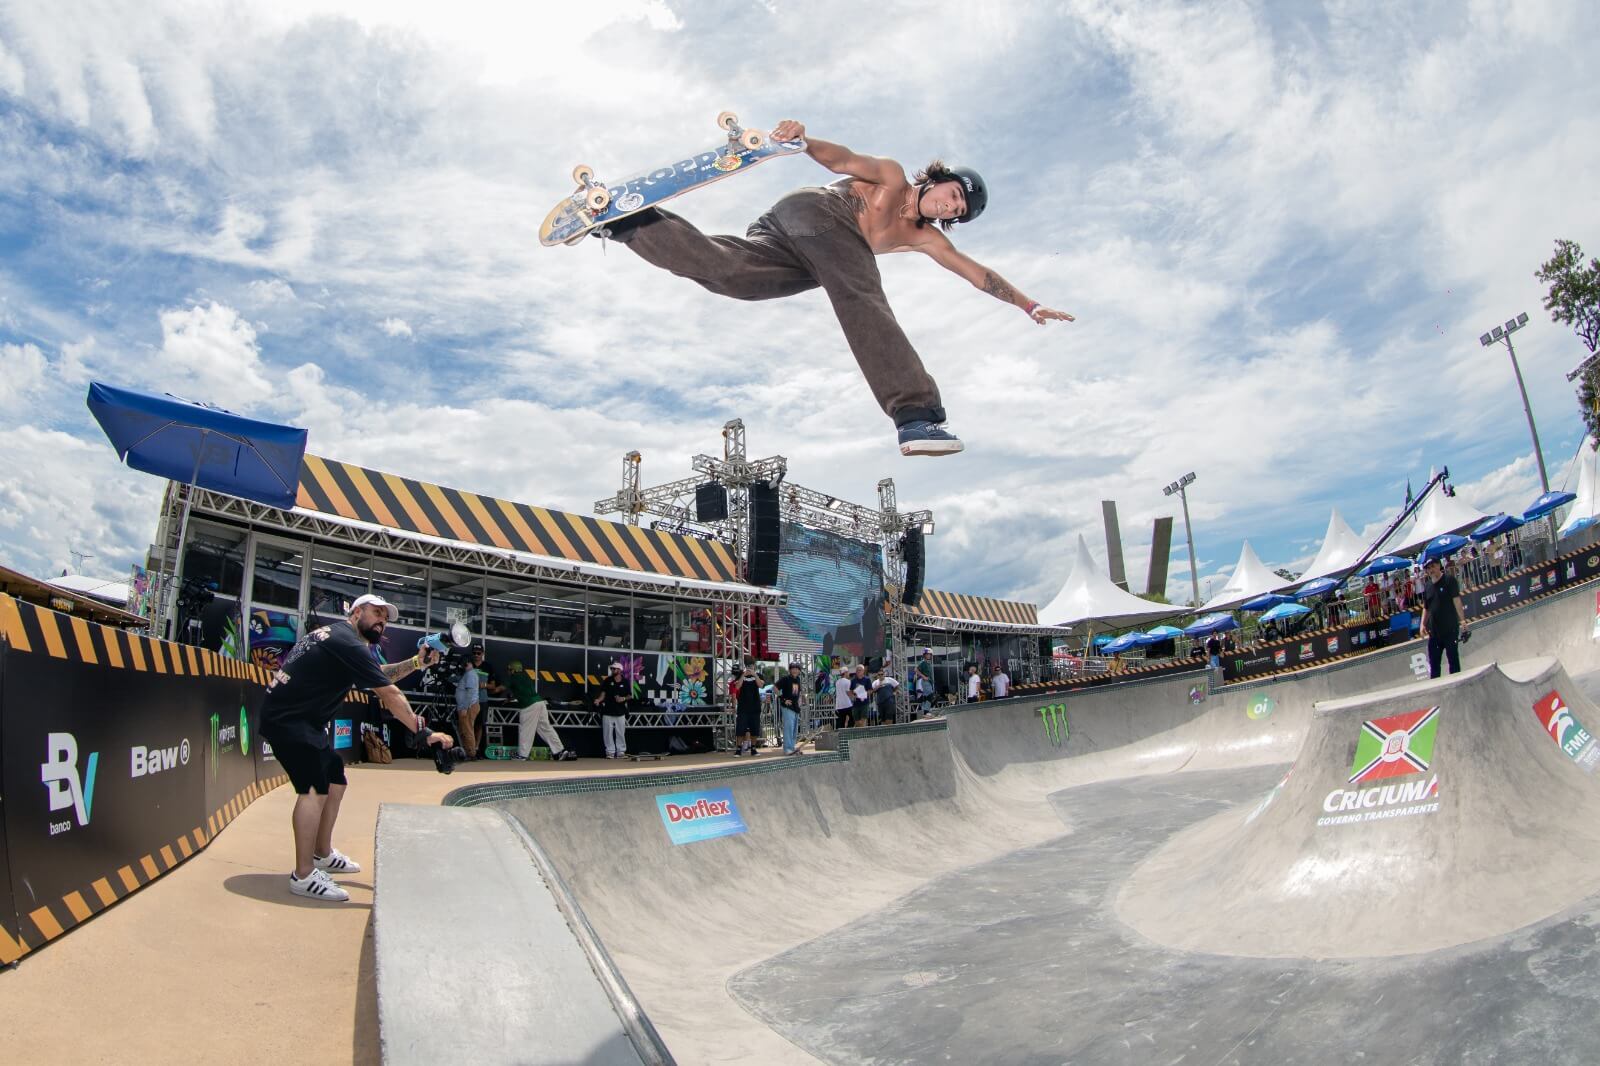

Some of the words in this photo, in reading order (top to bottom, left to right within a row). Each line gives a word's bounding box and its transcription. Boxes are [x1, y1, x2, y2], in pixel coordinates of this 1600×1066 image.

[1481, 593, 1497, 606] STU
[1254, 697, 1268, 714] oi
[1563, 728, 1591, 756] FME
[665, 799, 731, 823] Dorflex
[1317, 813, 1362, 826] GOVERNO
[1363, 802, 1439, 820] TRANSPARENTE
[49, 820, 71, 836] banco
